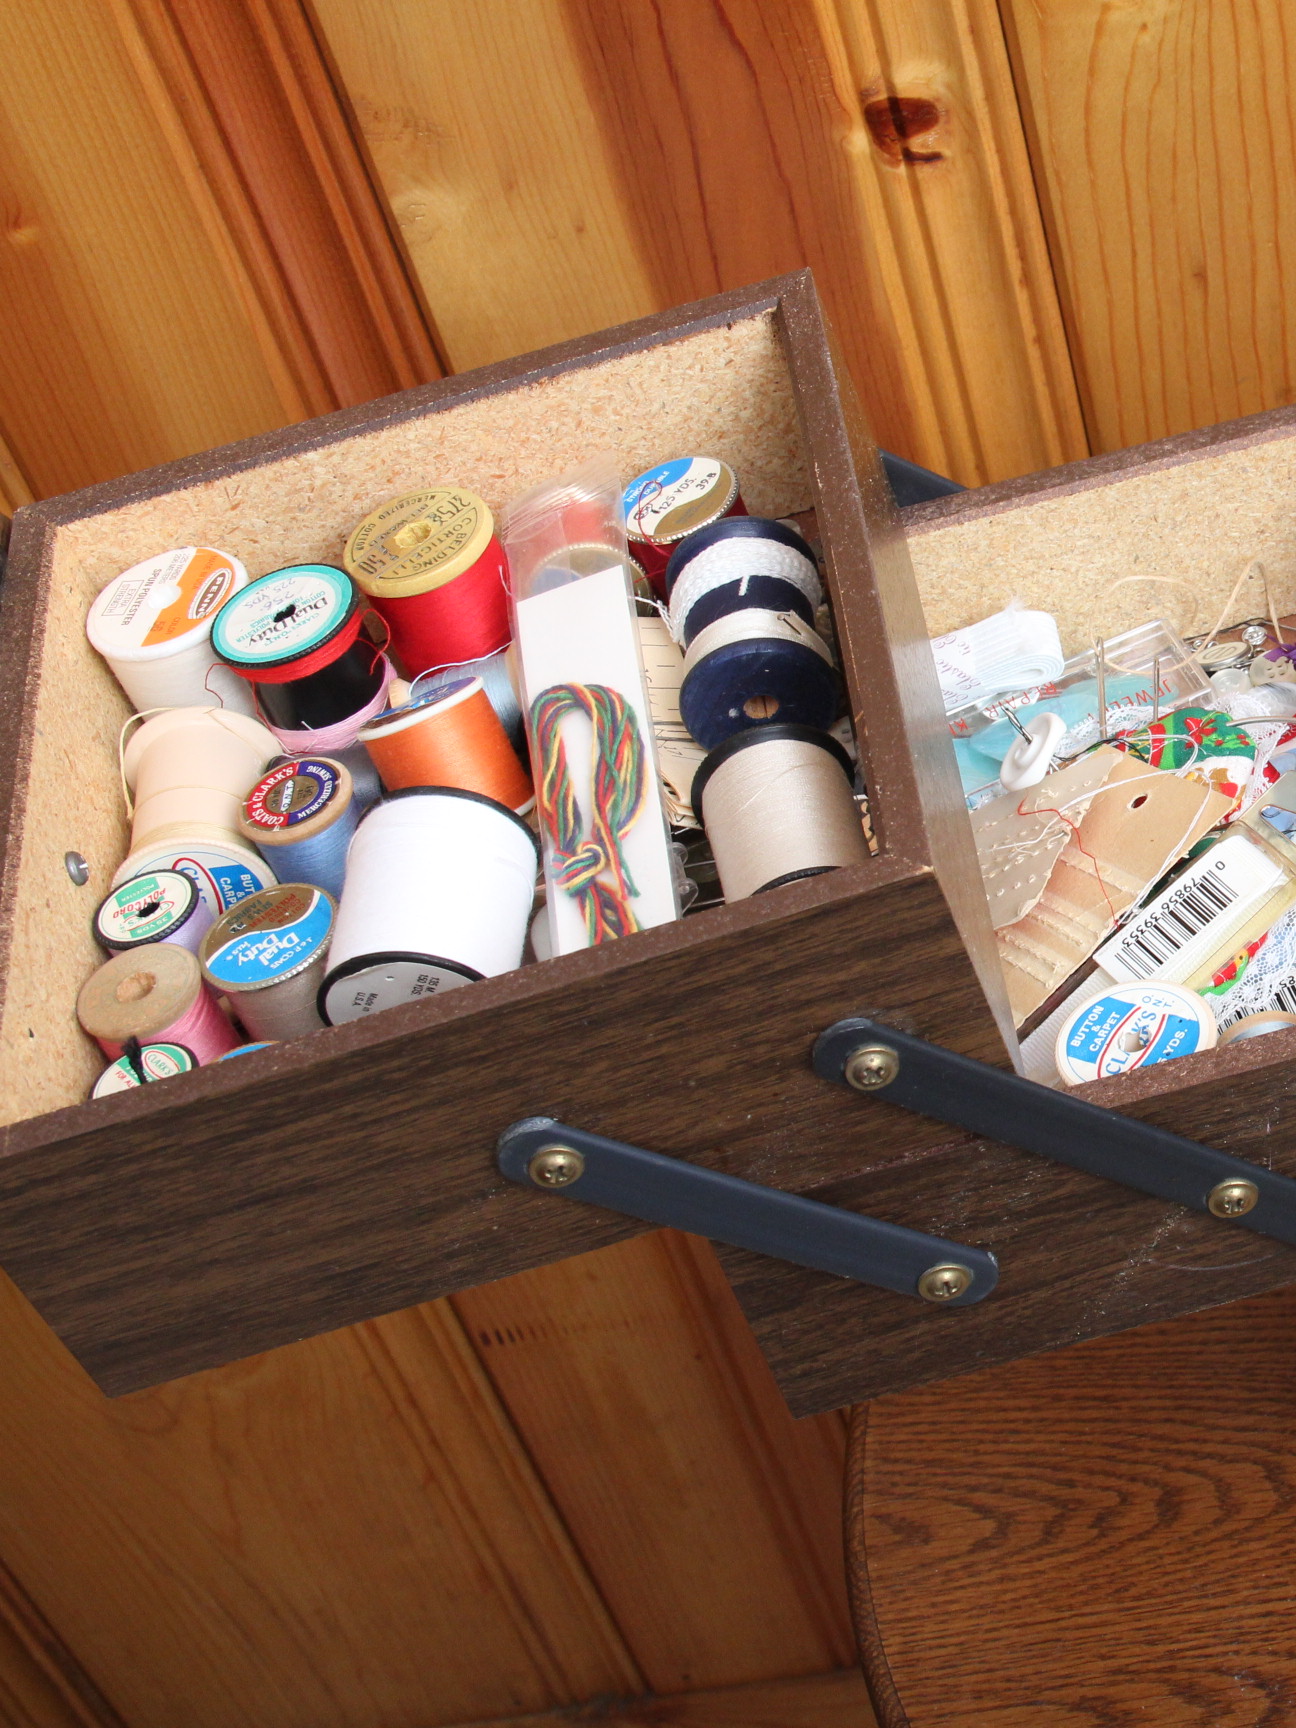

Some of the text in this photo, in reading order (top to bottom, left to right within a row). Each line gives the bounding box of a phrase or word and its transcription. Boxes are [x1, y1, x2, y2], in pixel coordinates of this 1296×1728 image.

[378, 494, 437, 520] MERCERIZED
[393, 517, 472, 576] CORTICELLI
[412, 532, 467, 571] BELDING
[118, 588, 138, 609] EXTRA
[121, 568, 162, 626] SPUN POLYESTER
[936, 658, 981, 691] Elastic
[252, 766, 294, 802] CLARK'S
[306, 765, 332, 781] SEWING
[297, 780, 334, 819] MERCERIZED
[252, 808, 285, 825] COATS
[113, 888, 166, 919] POLYCORD
[219, 877, 236, 908] CARP
[1121, 860, 1226, 949] 0 79856 39353
[238, 933, 280, 966] Duty
[259, 932, 300, 966] Dual
[1070, 1005, 1105, 1047] BUTTON
[1089, 1011, 1121, 1052] CARPET
[1091, 1024, 1102, 1033] &
[115, 1070, 127, 1081] FOR
[147, 1053, 174, 1076] CLARK'S
